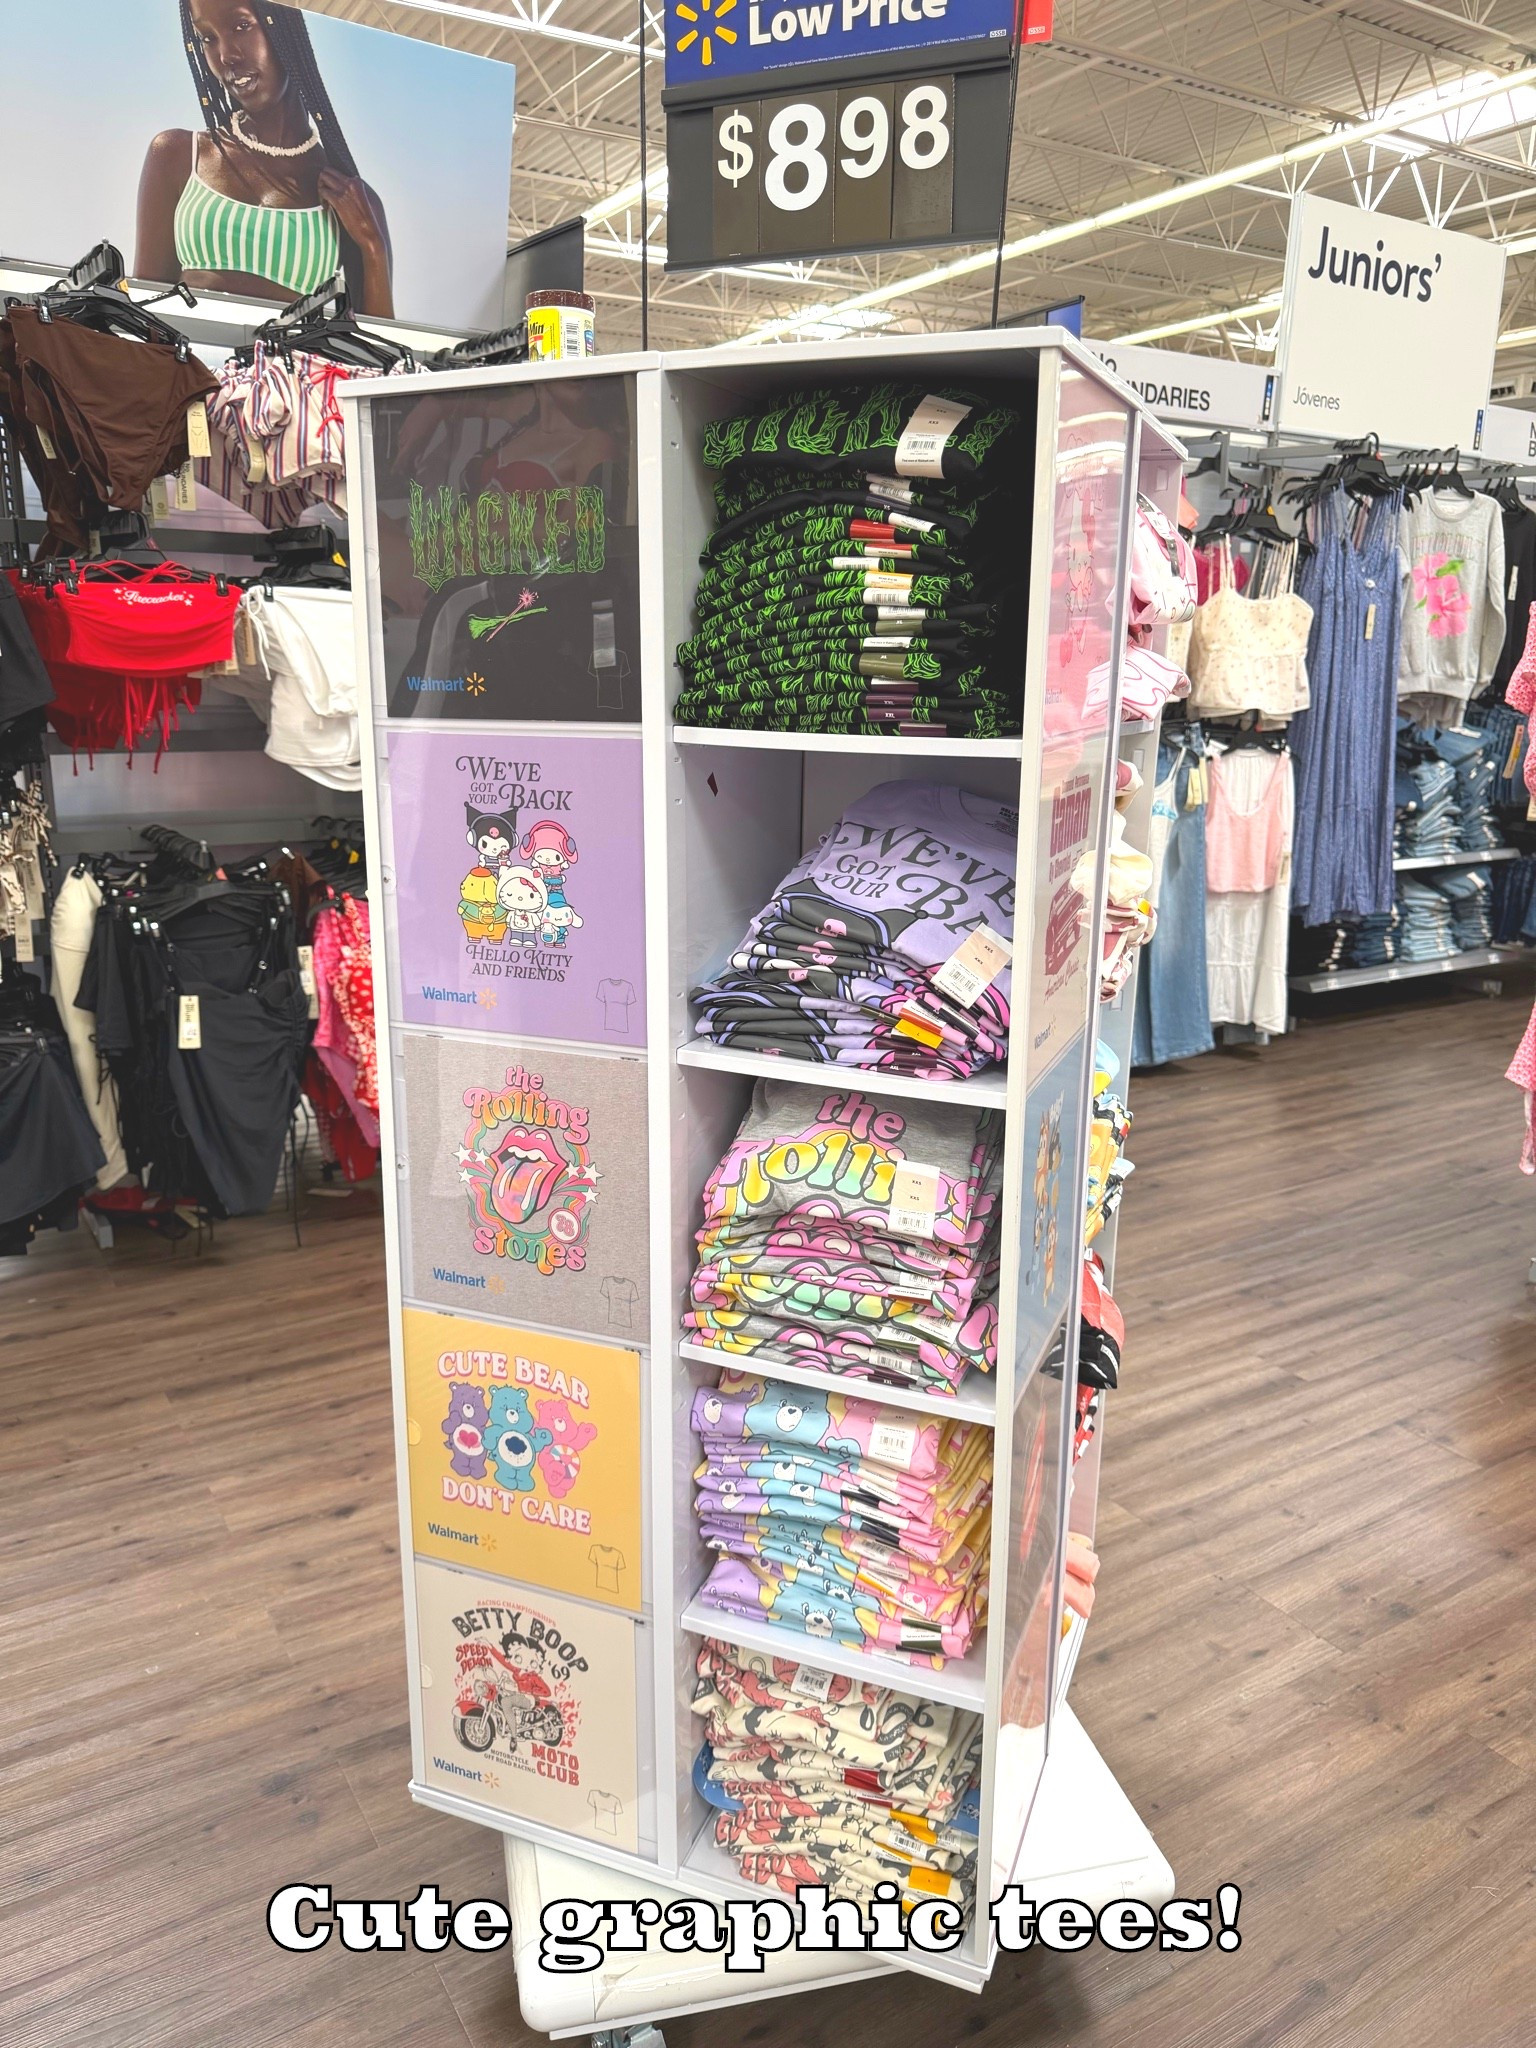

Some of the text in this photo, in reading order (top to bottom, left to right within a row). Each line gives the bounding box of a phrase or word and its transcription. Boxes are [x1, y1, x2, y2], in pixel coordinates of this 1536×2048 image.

[750, 0, 948, 46] Low Price
[1308, 226, 1443, 303] Juniors'
[1293, 387, 1341, 411] Jóvenes
[409, 479, 606, 593] WICKED
[123, 590, 185, 604] Firecracker
[407, 676, 464, 692] Walmart
[455, 756, 542, 782] WE'VE
[468, 783, 573, 811] YOUR BACK
[470, 782, 494, 793] GOT
[836, 853, 897, 880] GOT
[820, 870, 889, 899] YOUR
[466, 944, 573, 974] HELLO KITTY
[472, 962, 566, 983] AND FRIENDS
[422, 986, 477, 1004] Walmart
[506, 1065, 543, 1092] the
[463, 1087, 590, 1145] Rolling
[815, 1092, 907, 1142] the
[473, 1226, 586, 1276] Stones
[433, 1267, 486, 1289] Walmart
[438, 1350, 590, 1409] CUTE BEAR
[442, 1476, 591, 1535] DON'T CARE
[428, 1522, 480, 1546] Walmart
[477, 1599, 501, 1607] RACING
[451, 1608, 589, 1674] BETTY BOOP
[455, 1643, 489, 1663] SPEED
[460, 1659, 493, 1676] DEMON
[433, 1756, 482, 1782] Walmart
[484, 1753, 536, 1774] OFF ROAD RACING
[490, 1749, 529, 1765] MOTORCYCLE
[531, 1742, 579, 1771] MOTO
[536, 1760, 580, 1786] CLUB
